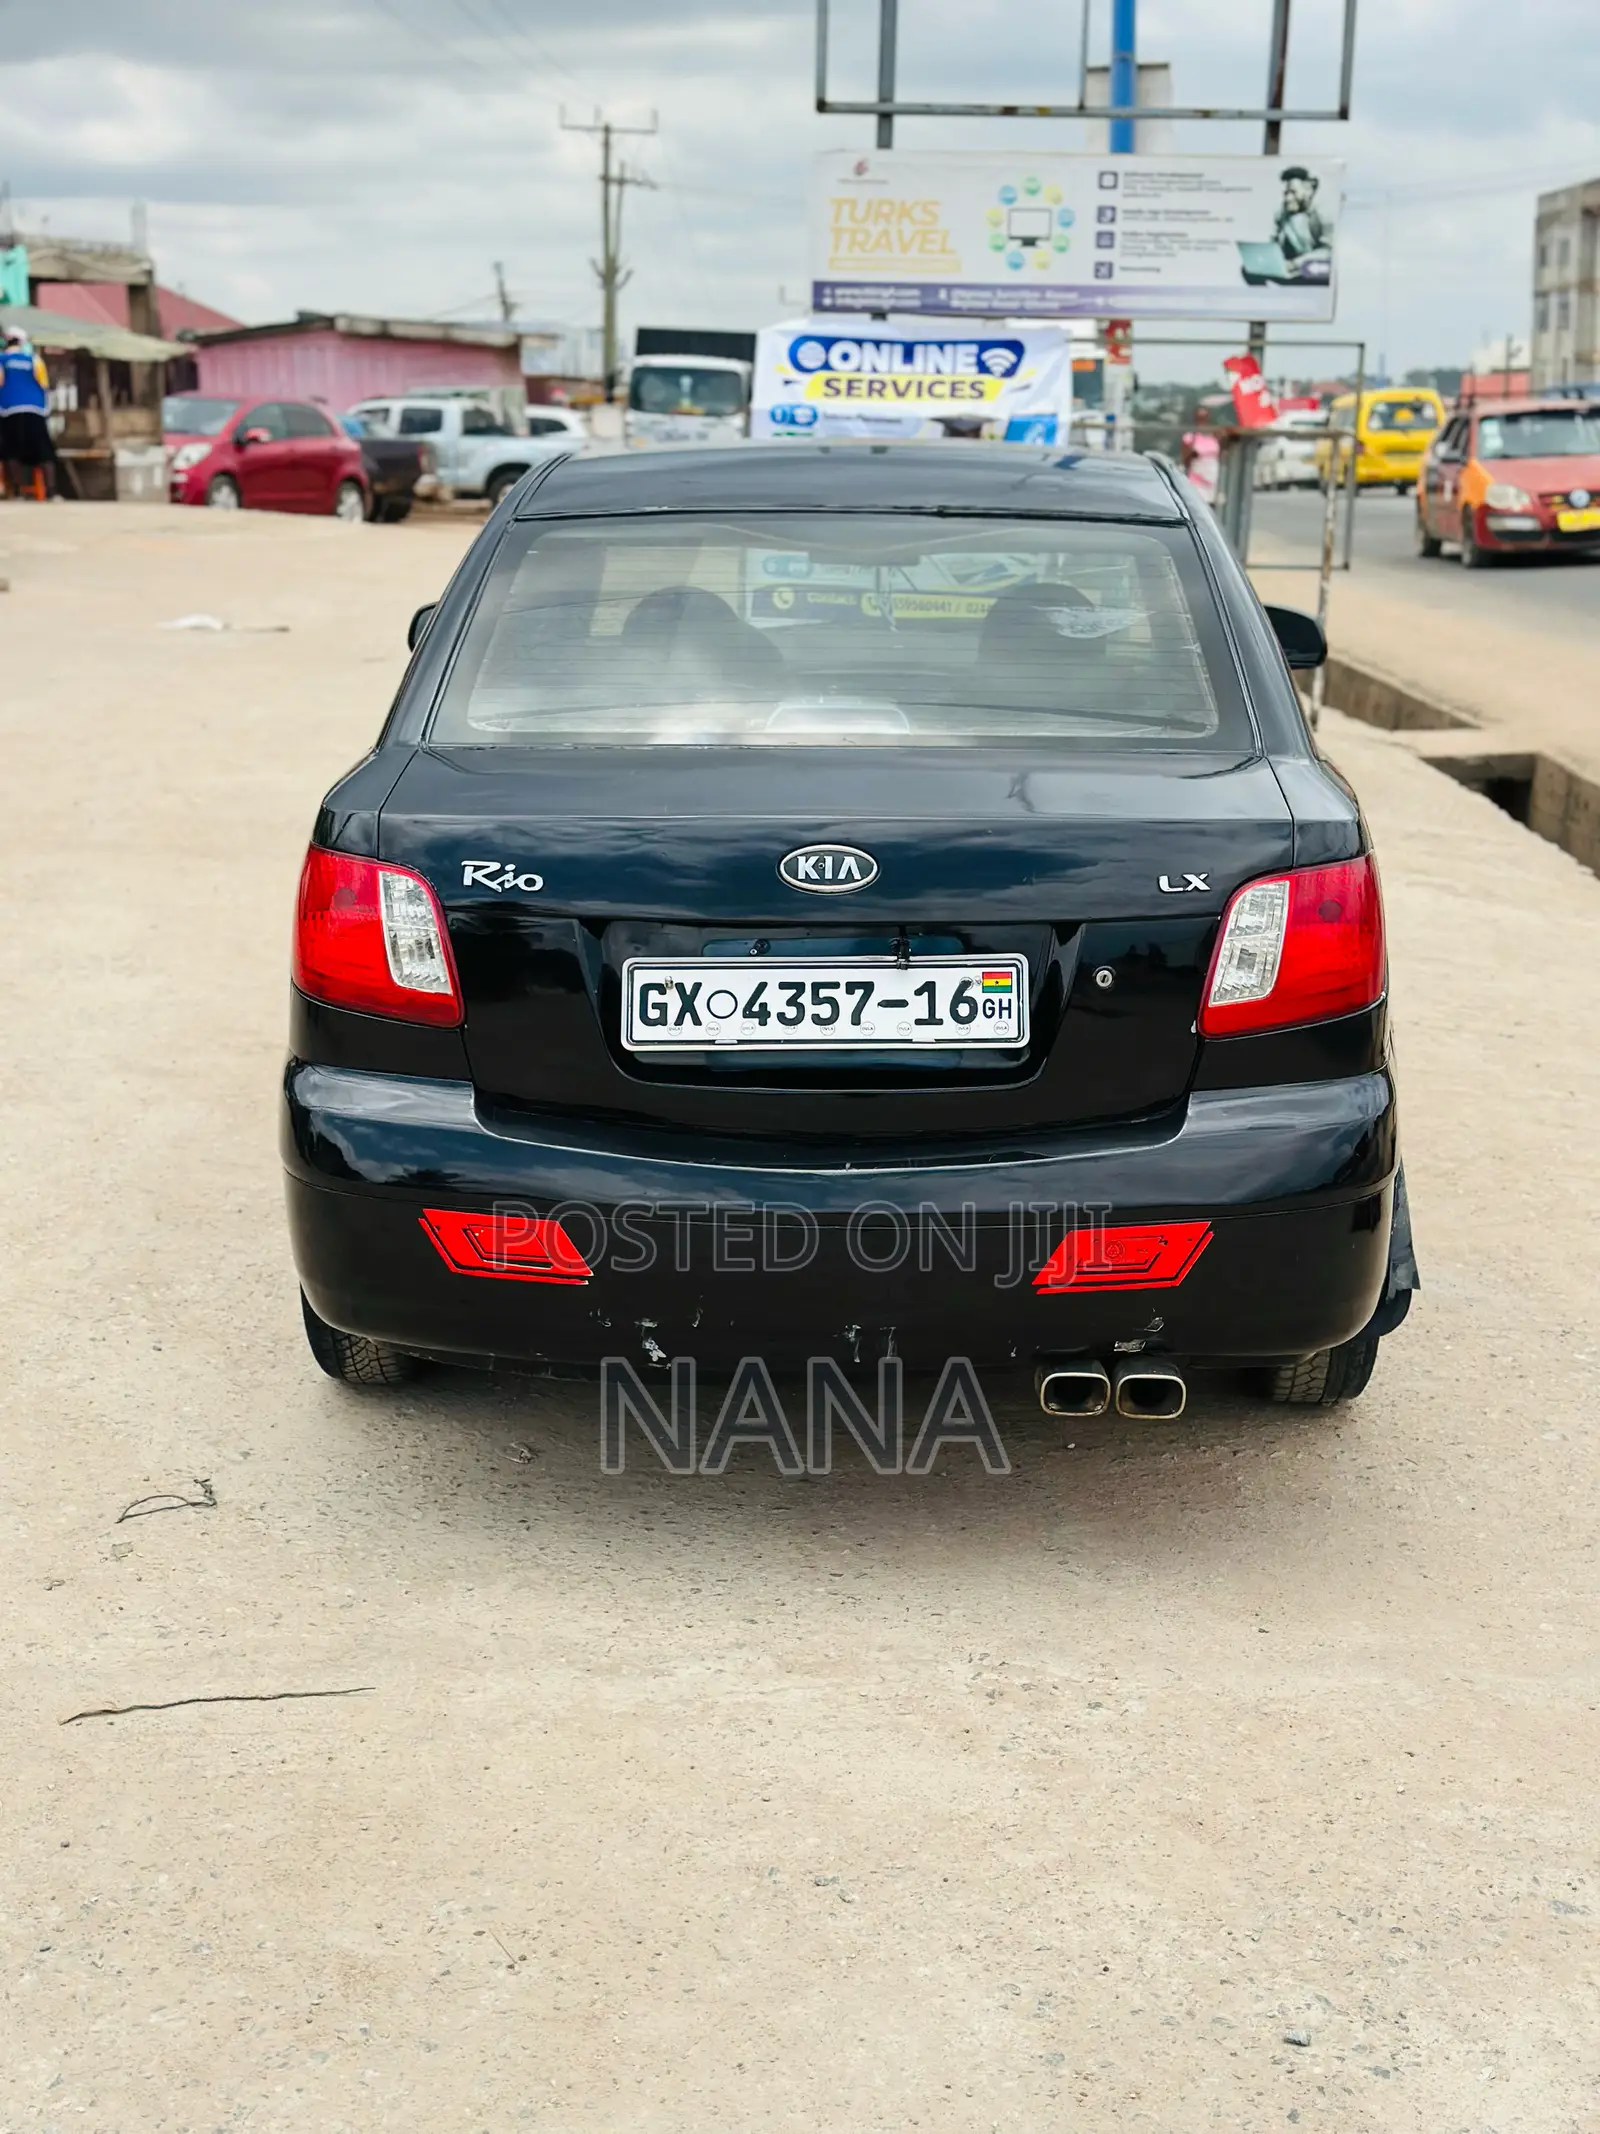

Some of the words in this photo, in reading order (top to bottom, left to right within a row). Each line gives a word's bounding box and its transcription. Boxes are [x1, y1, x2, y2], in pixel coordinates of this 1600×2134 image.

[829, 198, 941, 226] TURKS
[829, 227, 958, 254] TRAVEL
[828, 339, 980, 374] ONLINE
[823, 377, 986, 399] SERVICES
[460, 860, 544, 893] Rio
[796, 855, 863, 880] KIA
[1158, 873, 1212, 893] LX
[639, 981, 703, 1027] GX
[741, 980, 979, 1027] 4357-16
[982, 998, 1012, 1020] GH
